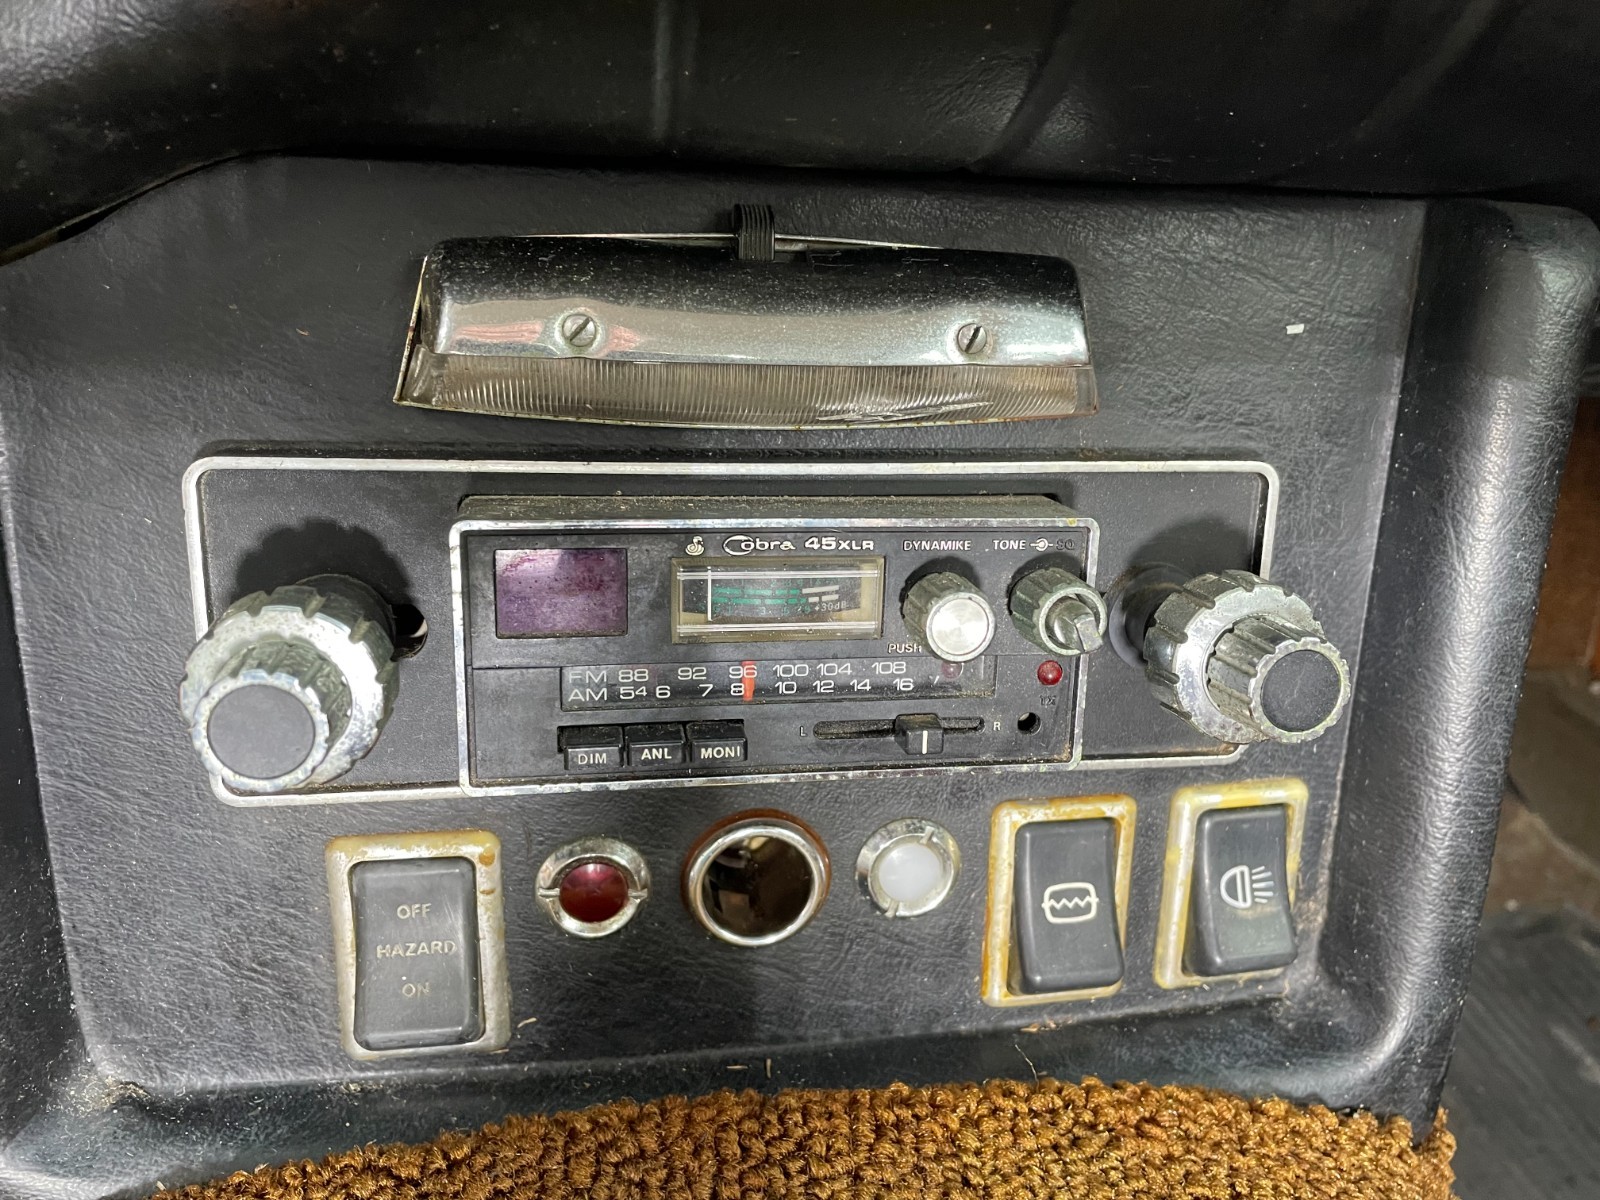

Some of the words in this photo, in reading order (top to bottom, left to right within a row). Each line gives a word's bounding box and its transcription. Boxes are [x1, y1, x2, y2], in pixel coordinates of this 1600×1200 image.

[722, 535, 796, 556] Cobra
[804, 536, 875, 551] 45XLR
[903, 540, 972, 551] DYNAMIKE
[993, 540, 1027, 551] TONE
[888, 643, 923, 654] PUSH
[568, 670, 607, 684] FM
[618, 668, 649, 683] 88
[677, 666, 707, 680] 92
[728, 664, 758, 679] 96
[772, 664, 809, 678] 100
[816, 662, 853, 676] 104
[871, 661, 907, 675] 108
[568, 687, 608, 702] AM
[619, 685, 648, 700] 54
[655, 685, 671, 699] 6
[699, 683, 714, 697] 7
[730, 682, 745, 696] 8
[774, 681, 797, 695] 10
[812, 679, 835, 693] 12
[849, 678, 872, 692] 14
[892, 677, 914, 691] 16
[800, 726, 808, 737] L
[992, 721, 1001, 731] R
[578, 753, 607, 765] DIM
[641, 747, 672, 760] ANL
[700, 746, 741, 759] MONI
[396, 903, 432, 919] OFF
[376, 940, 456, 958] HAZARD
[402, 981, 431, 997] ON
